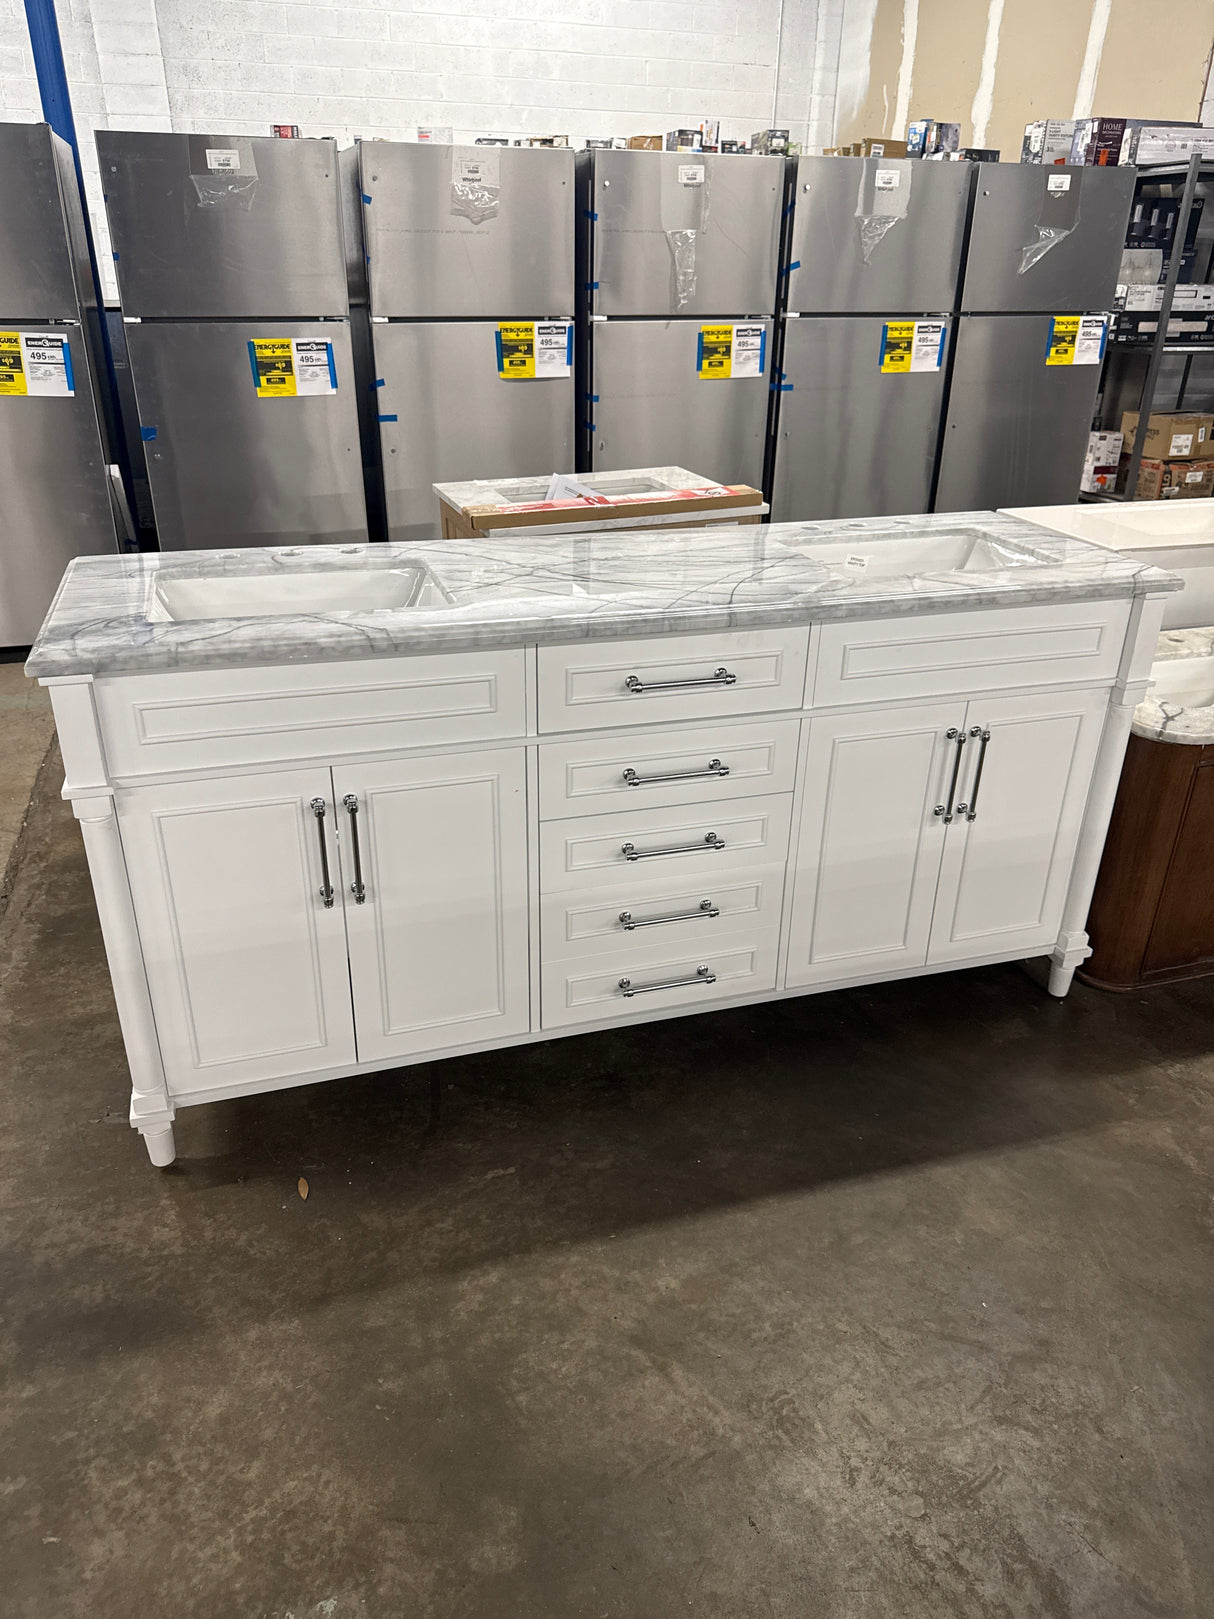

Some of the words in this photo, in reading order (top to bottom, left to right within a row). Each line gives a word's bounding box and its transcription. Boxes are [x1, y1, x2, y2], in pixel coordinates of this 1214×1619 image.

[1103, 122, 1123, 131] HOME
[30, 352, 47, 360] 495
[300, 355, 314, 363] 495
